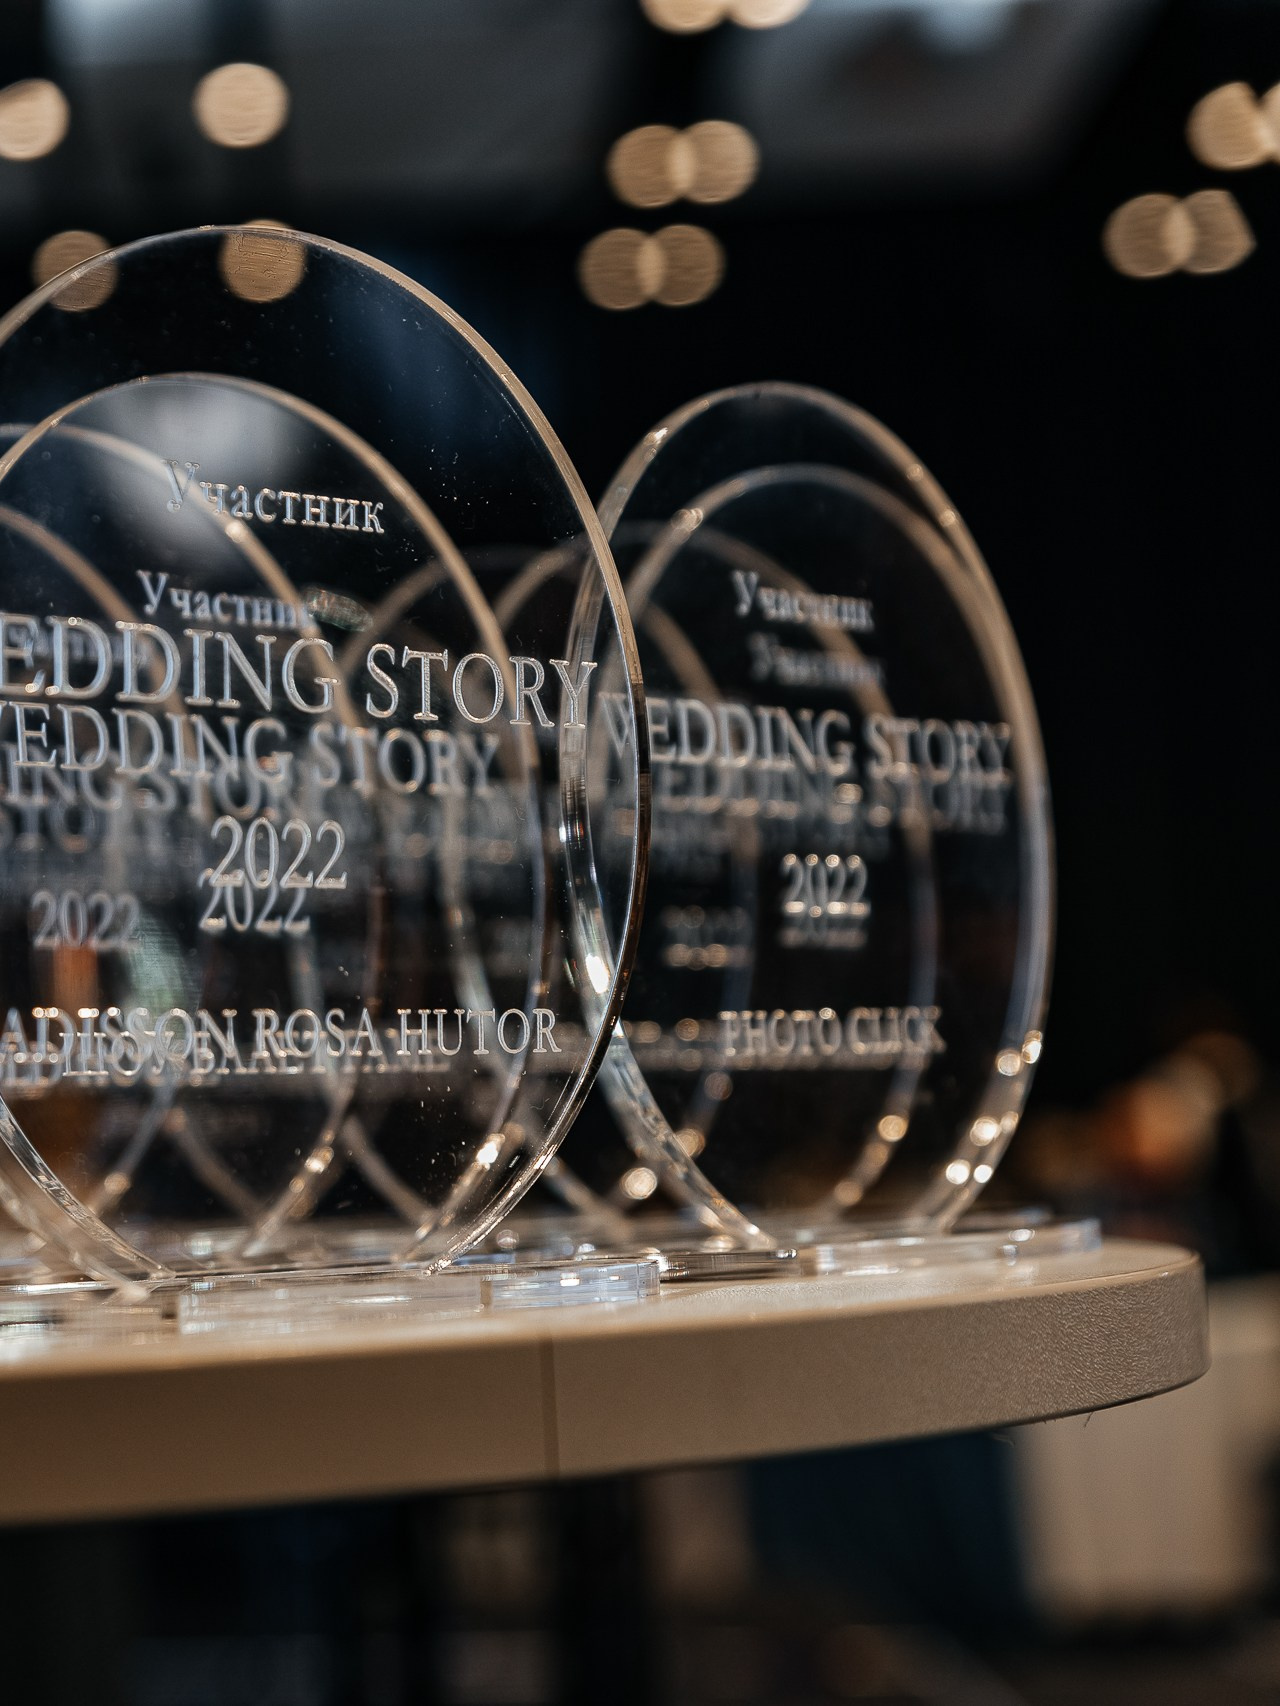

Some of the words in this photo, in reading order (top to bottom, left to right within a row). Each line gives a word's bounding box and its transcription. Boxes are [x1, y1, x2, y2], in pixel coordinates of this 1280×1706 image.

[161, 459, 385, 534] Участник
[365, 642, 599, 730] STORY
[309, 720, 501, 800] STORY
[862, 711, 1012, 786] STORY
[210, 815, 348, 889] 2022
[781, 852, 871, 920] 2022
[31, 887, 144, 951] 2022
[198, 866, 312, 934] 2022
[251, 1006, 384, 1059] ROSA
[396, 1006, 563, 1057] HUTOR
[718, 1008, 843, 1057] PHOTO
[846, 1005, 948, 1056] CLICK
